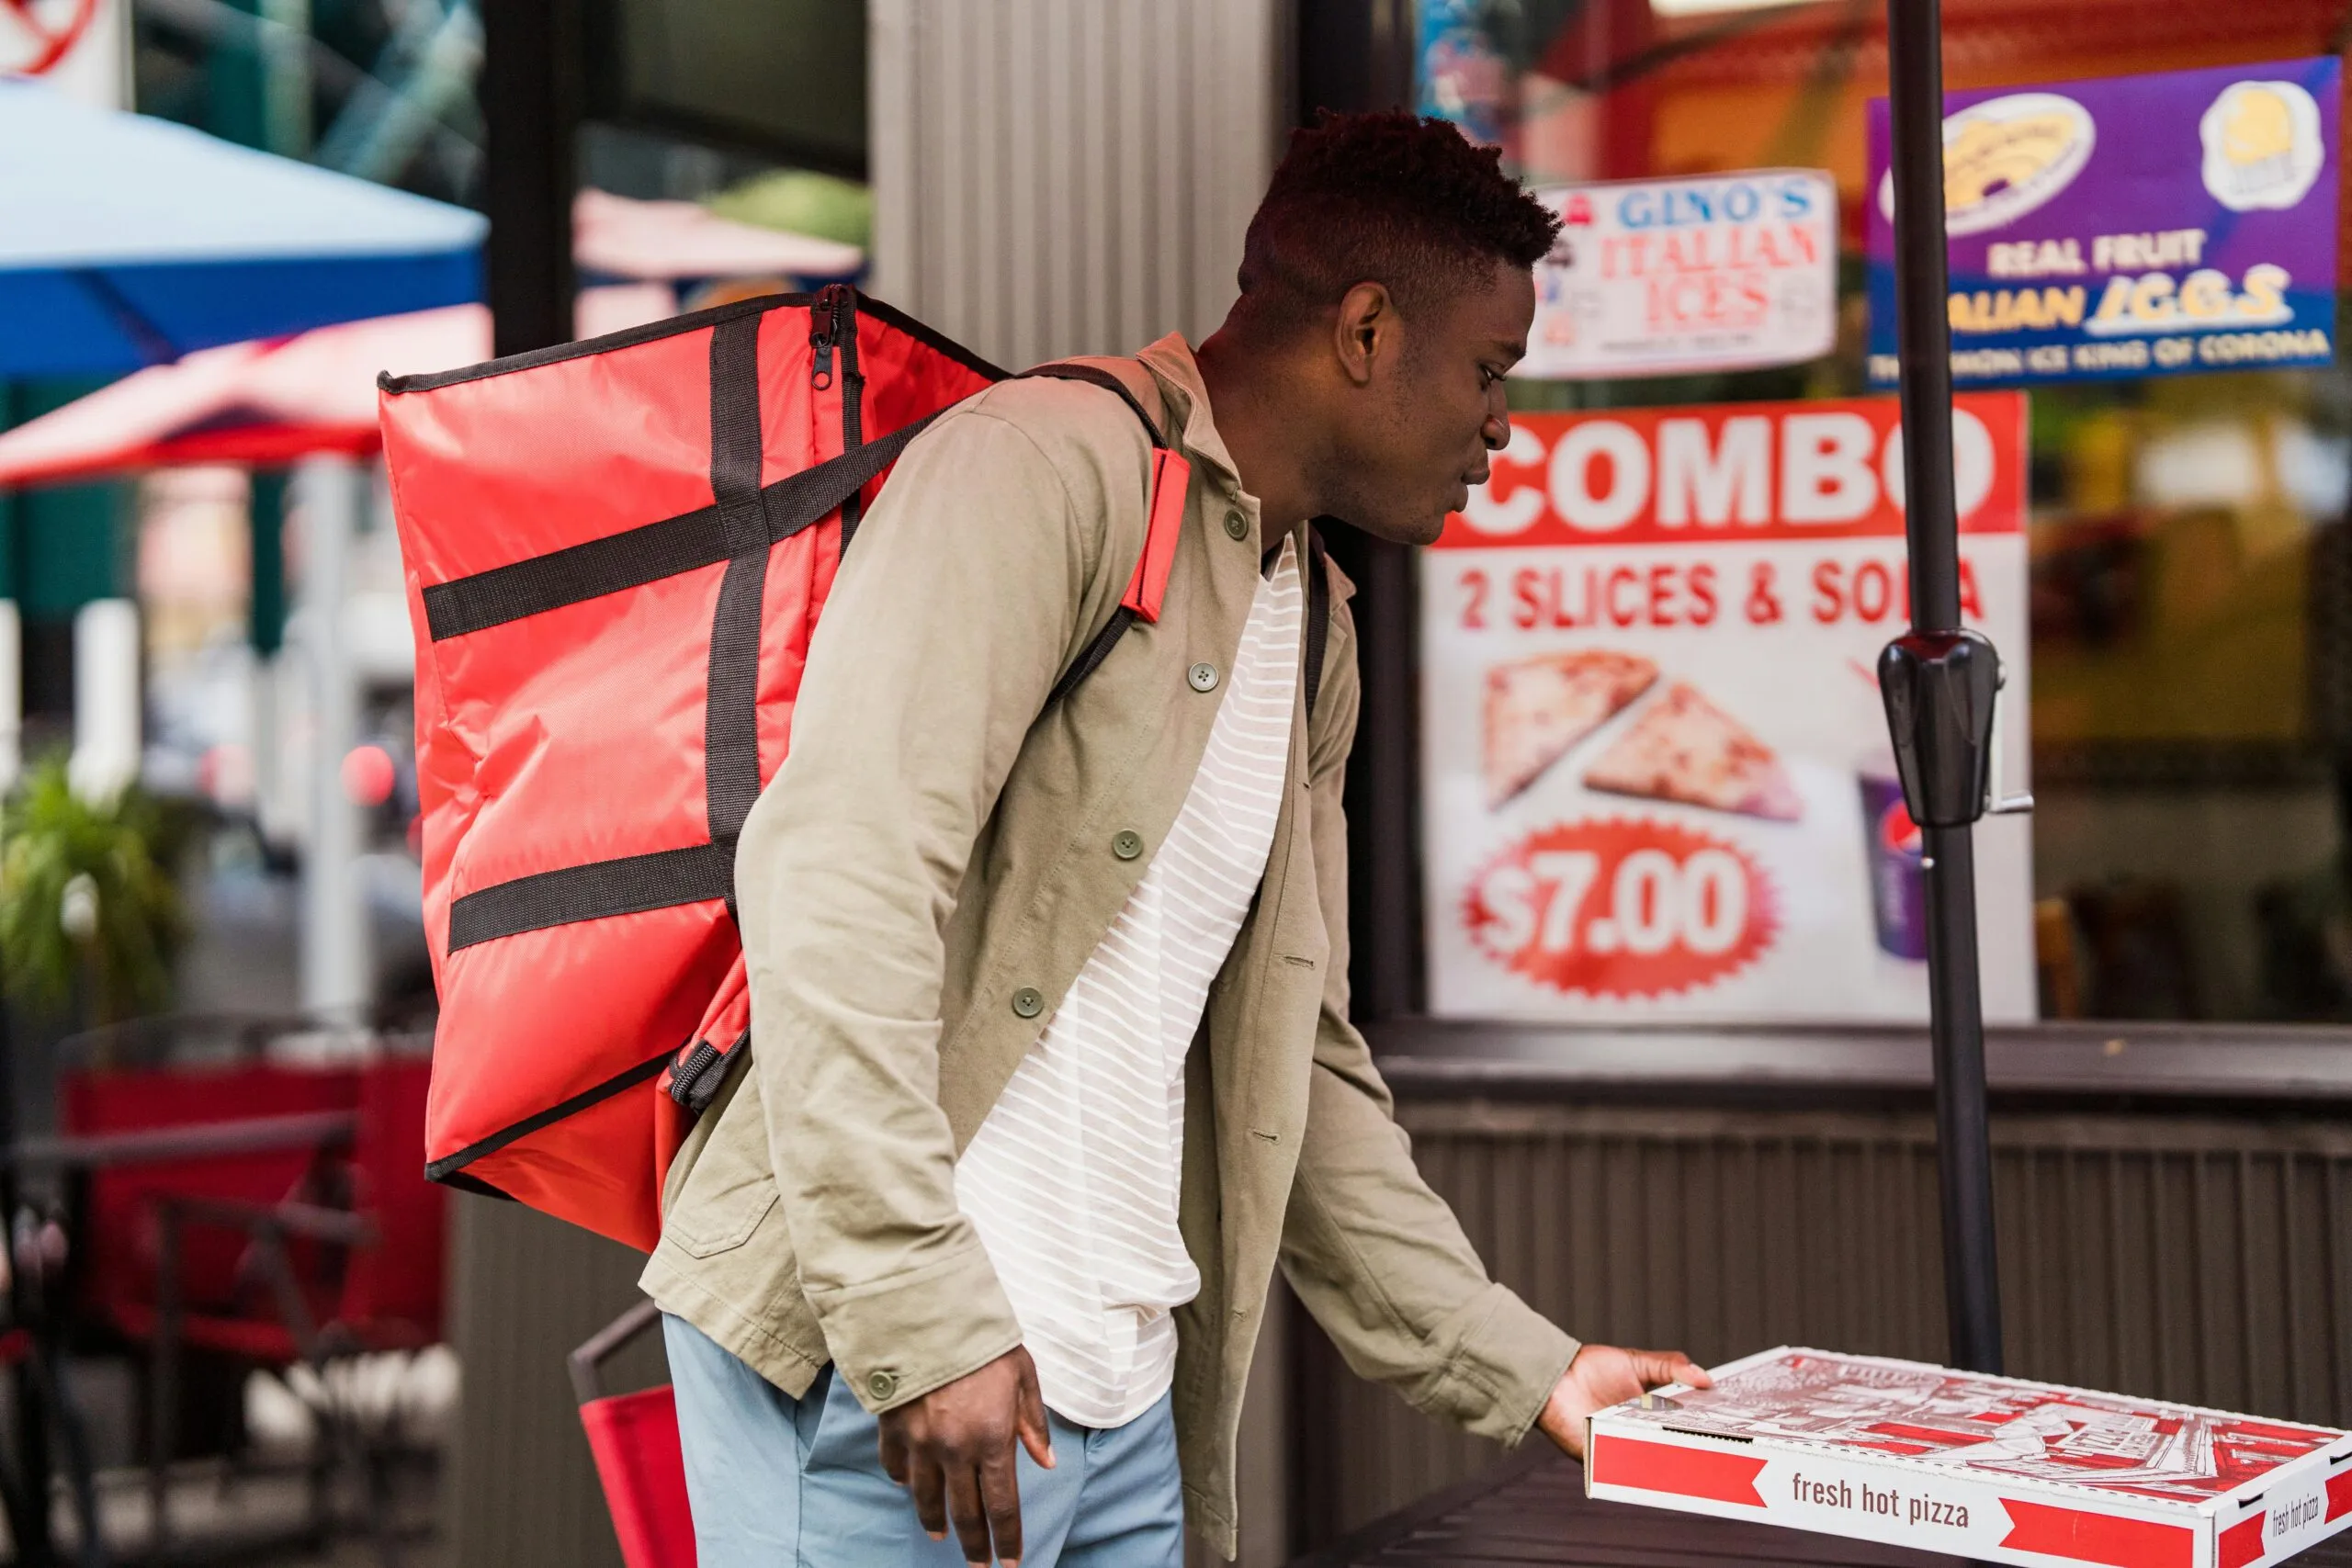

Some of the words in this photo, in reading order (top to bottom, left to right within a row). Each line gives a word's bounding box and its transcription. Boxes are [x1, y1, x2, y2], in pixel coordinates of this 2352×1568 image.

[1618, 179, 1813, 229] GINO'S
[1600, 225, 1816, 279] ITALIAN
[1987, 239, 2089, 278] REAL
[2092, 229, 2207, 271] FRUIT
[1645, 275, 1770, 330] ICES
[2074, 340, 2149, 371] KING
[2154, 336, 2194, 367] OF
[2199, 329, 2330, 364] CORONA
[1458, 569, 1490, 628] 2
[1511, 563, 1719, 630] SLICES
[1745, 562, 1784, 626] &
[1811, 558, 1984, 624] SOA
[1480, 848, 1748, 956] $7.00
[1792, 1472, 1851, 1508] fresh
[1862, 1483, 1899, 1517] hot
[1909, 1493, 1969, 1528] pizza
[2273, 1504, 2289, 1538] fresh
[2290, 1498, 2301, 1529] hot
[2302, 1493, 2319, 1529] pizza
